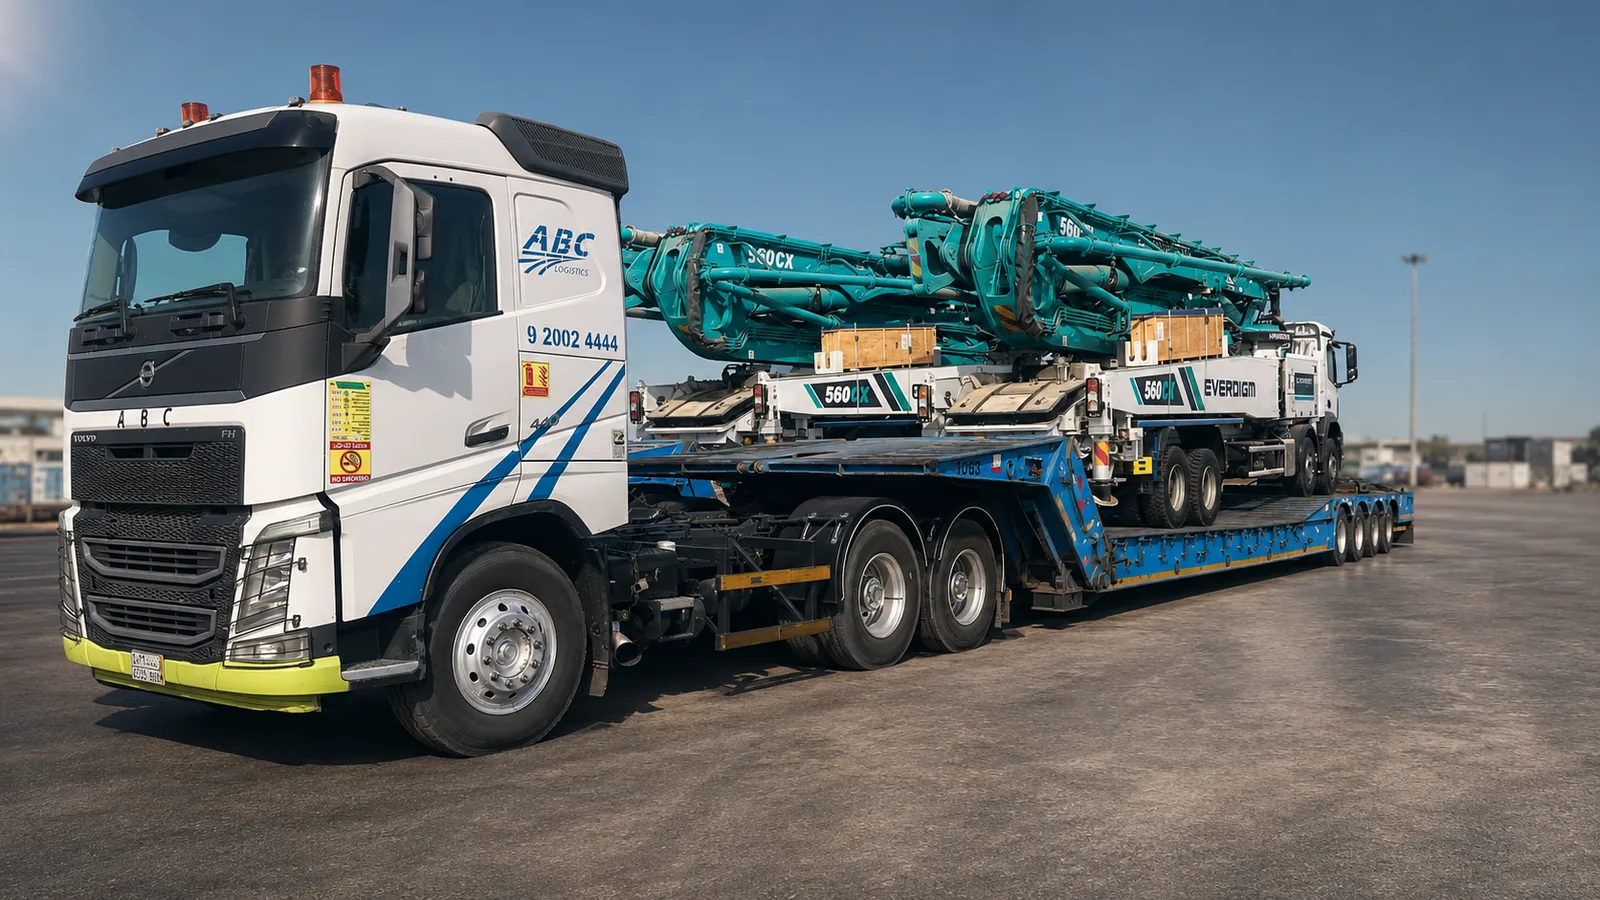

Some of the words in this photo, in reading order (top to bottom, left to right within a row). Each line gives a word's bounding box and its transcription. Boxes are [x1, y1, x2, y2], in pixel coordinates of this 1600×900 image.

[1060, 216, 1094, 238] 560
[522, 225, 595, 257] ABC
[747, 247, 795, 270] 560CX
[554, 265, 589, 277] LOGISTICS
[527, 325, 537, 344] 9
[542, 327, 580, 348] 2002
[584, 332, 618, 352] 4444
[825, 385, 870, 404] 560CX
[1204, 379, 1256, 398] EVERDIGM
[221, 430, 237, 439] FH
[957, 460, 981, 476] 1063
